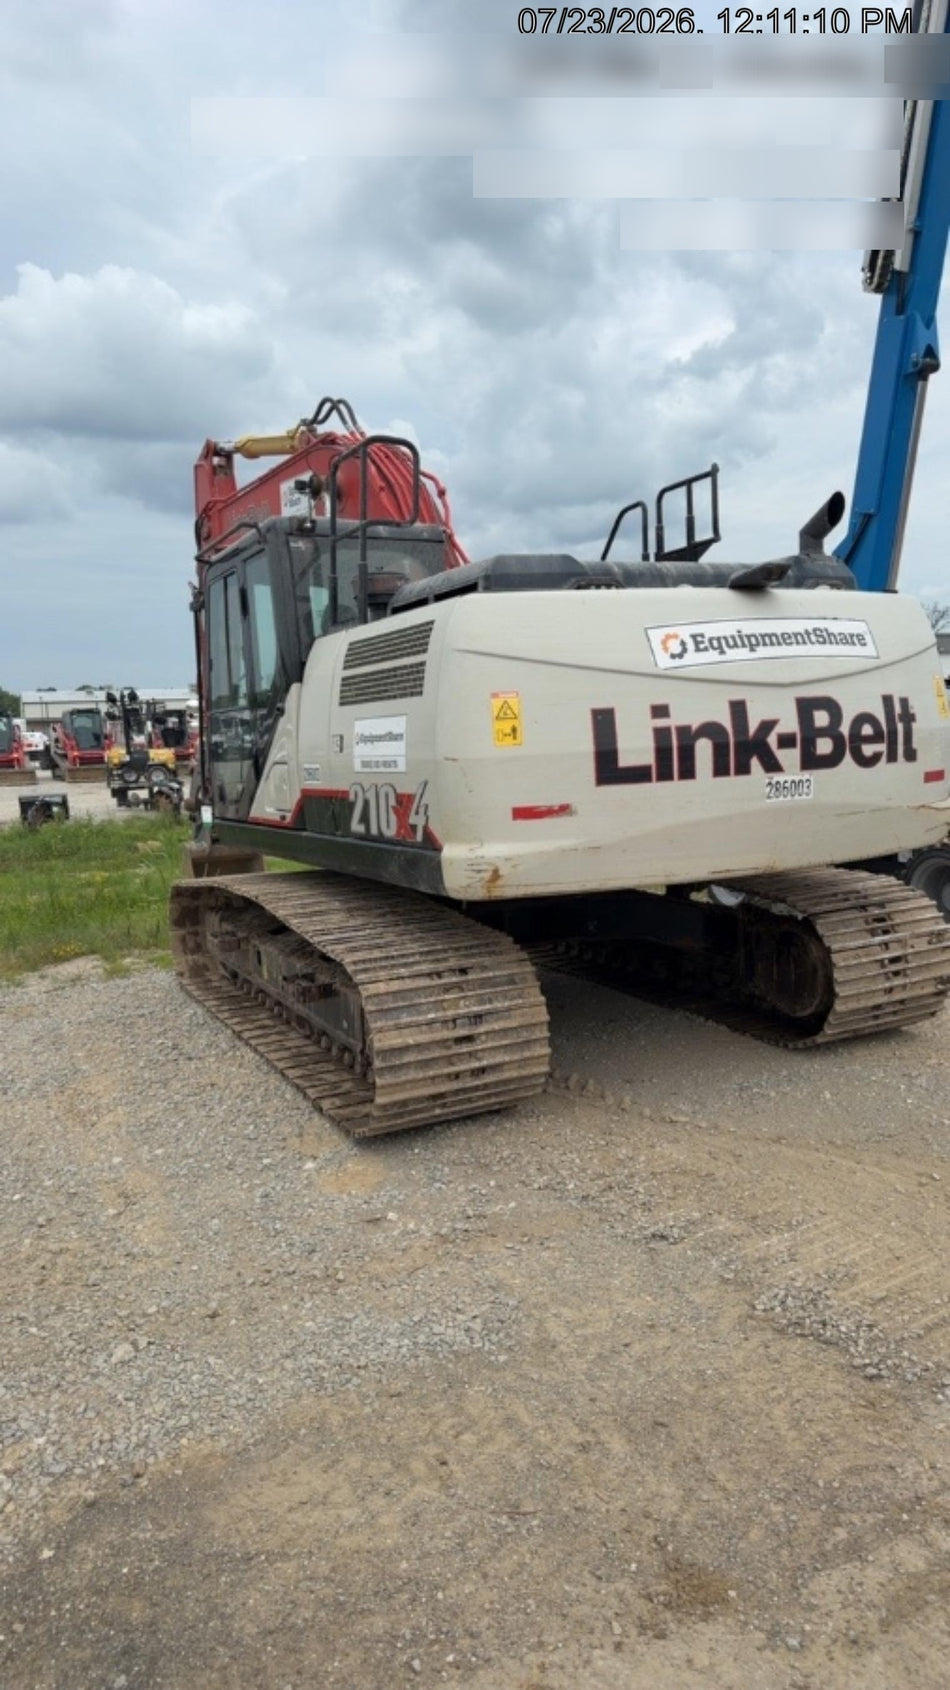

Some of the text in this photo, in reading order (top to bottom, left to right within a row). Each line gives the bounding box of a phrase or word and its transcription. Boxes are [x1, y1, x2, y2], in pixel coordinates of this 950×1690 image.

[689, 627, 868, 655] EquipmentShare
[590, 694, 917, 787] Link-Belt
[765, 778, 812, 800] 286003
